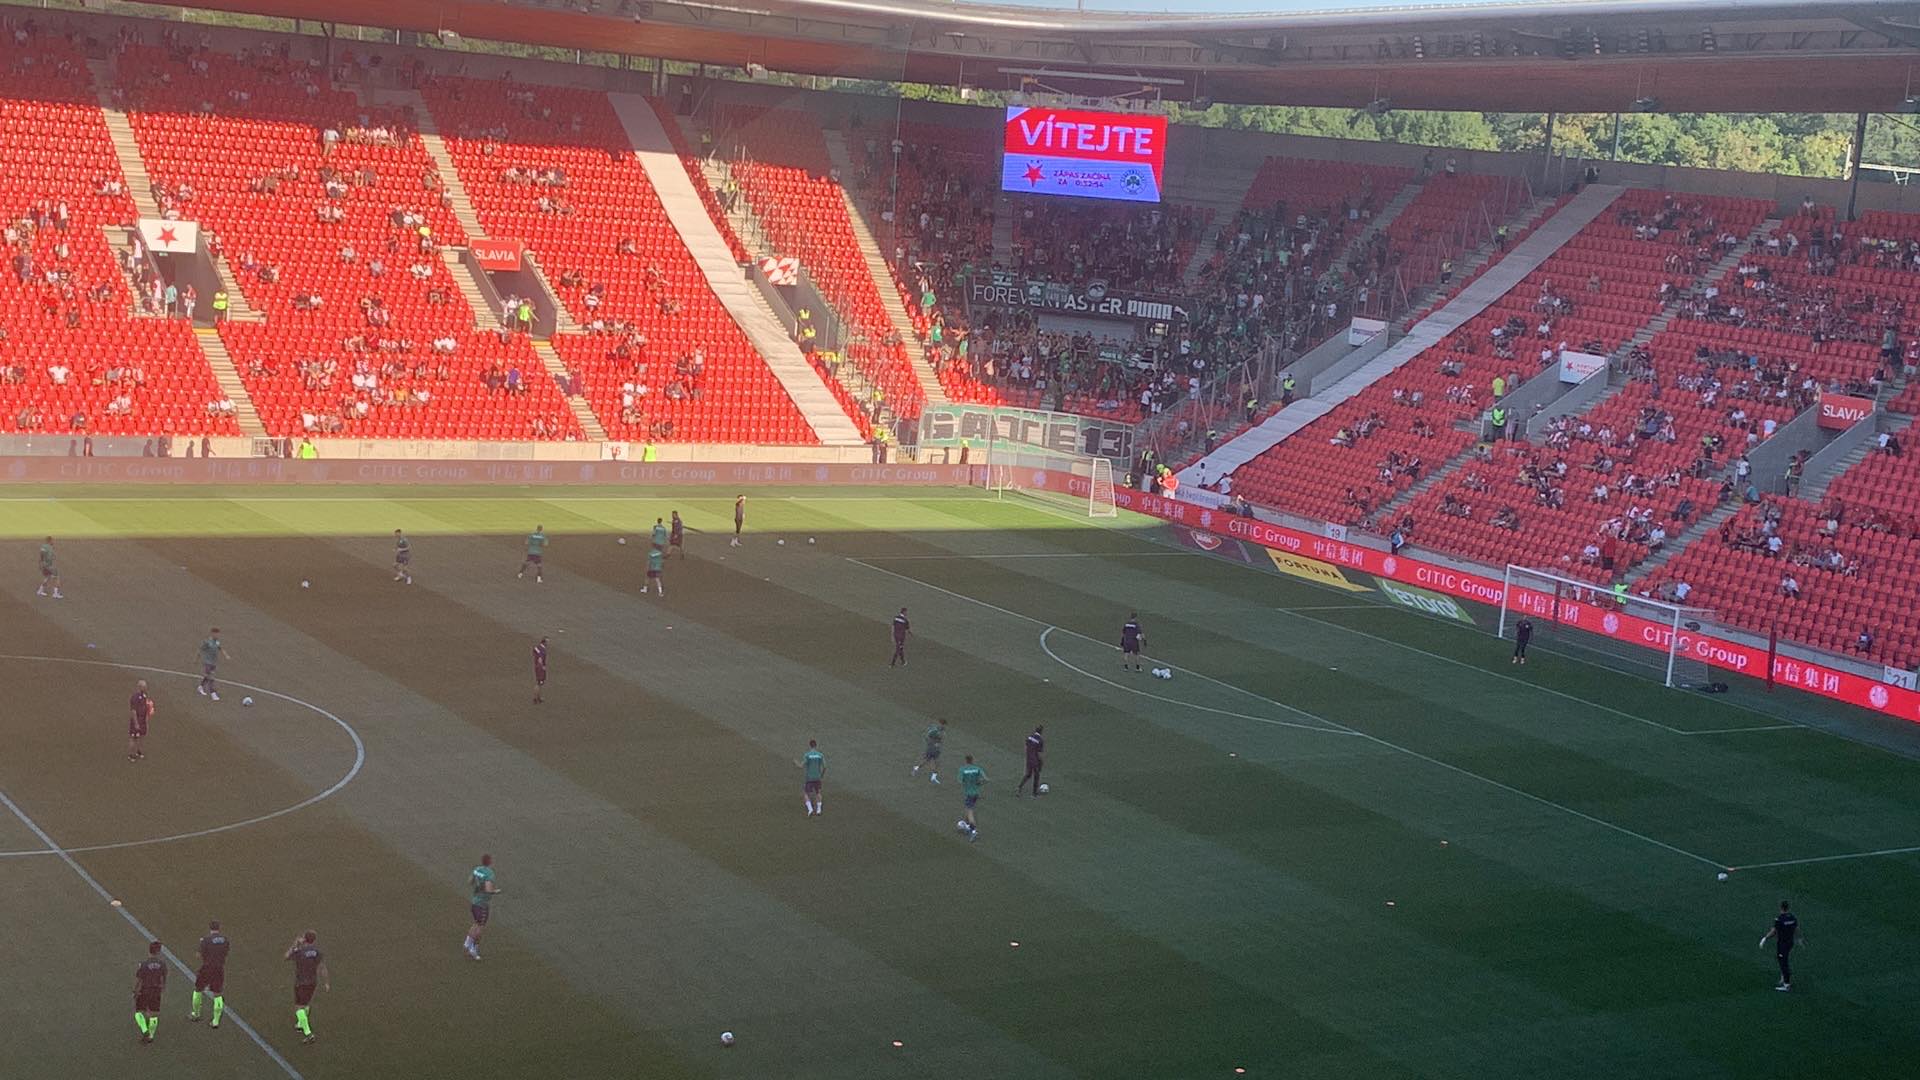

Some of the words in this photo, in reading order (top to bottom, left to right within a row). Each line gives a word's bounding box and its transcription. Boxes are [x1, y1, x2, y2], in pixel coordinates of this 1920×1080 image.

[1020, 114, 1153, 155] VÍTEJTE
[475, 248, 516, 261] SLAVIA
[973, 284, 1053, 308] FOREV
[1127, 299, 1174, 320] PUMA
[1822, 403, 1866, 421] SLAVIA
[126, 463, 184, 480] Group
[359, 464, 409, 478] CITIC
[415, 465, 468, 480] Group
[620, 466, 666, 480] CITIC
[671, 467, 716, 482] Group
[850, 467, 889, 481] CITIC
[896, 467, 938, 483] Group
[1229, 519, 1263, 539] CITIC
[1265, 528, 1301, 552] Group
[1330, 527, 1341, 539] 19
[1275, 556, 1342, 580] FORTUNA
[1416, 566, 1457, 589] CITIC
[1460, 578, 1503, 602] Group
[1643, 626, 1691, 652] CITC
[1696, 641, 1748, 670] Group
[1893, 673, 1907, 688] 21
